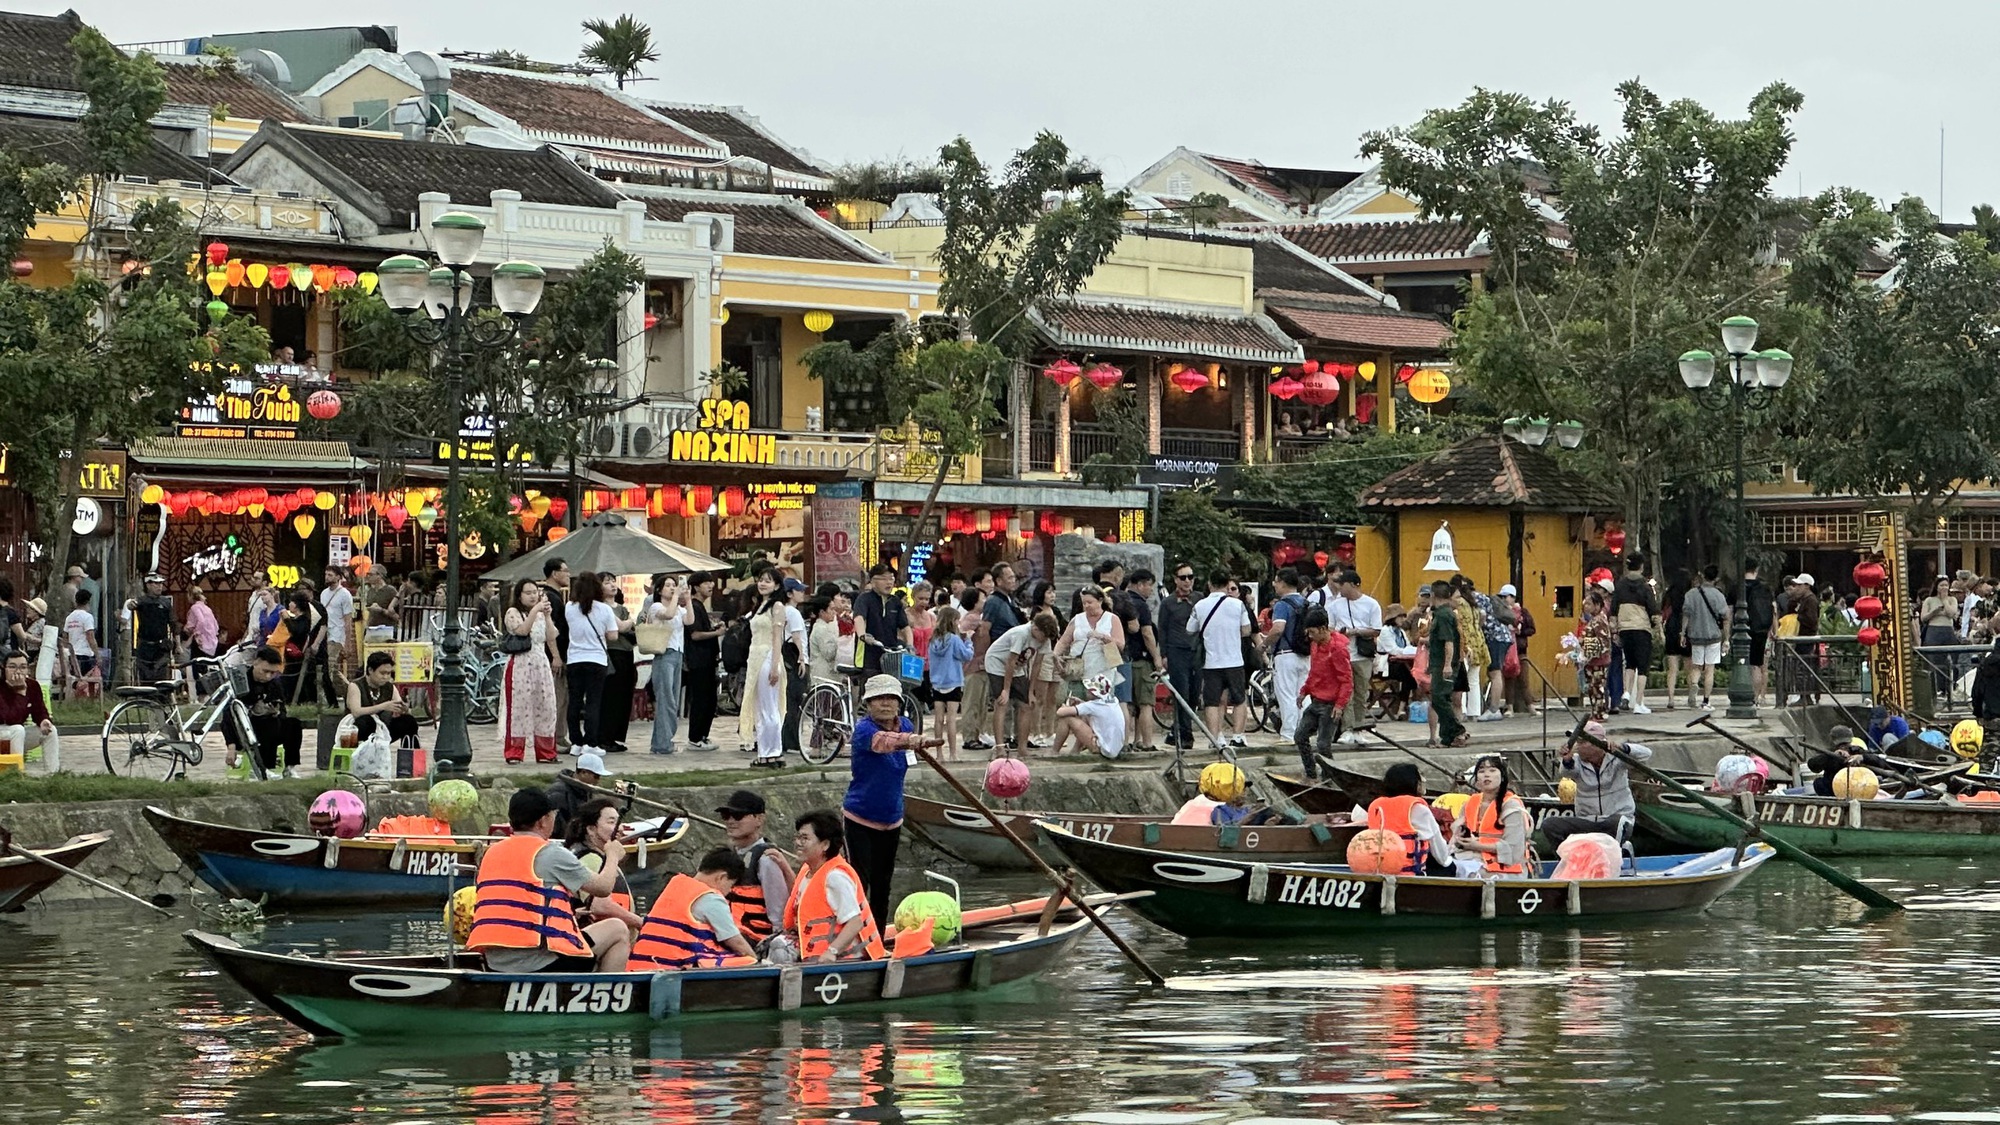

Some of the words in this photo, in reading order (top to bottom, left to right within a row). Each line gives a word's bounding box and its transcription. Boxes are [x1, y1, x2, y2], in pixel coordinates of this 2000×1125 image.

[192, 407, 220, 423] NAIL
[252, 384, 300, 422] Touch
[700, 399, 750, 430] SPA
[671, 430, 776, 464] NAXINH
[1155, 458, 1194, 473] MORNING
[1194, 460, 1219, 475] GLORY
[803, 483, 816, 494] CHU
[816, 530, 857, 557] 30%
[1433, 554, 1452, 563] TICKET
[267, 564, 300, 588] SPA
[1759, 802, 1842, 826] H.A.019
[504, 982, 633, 1013] H.A.259
